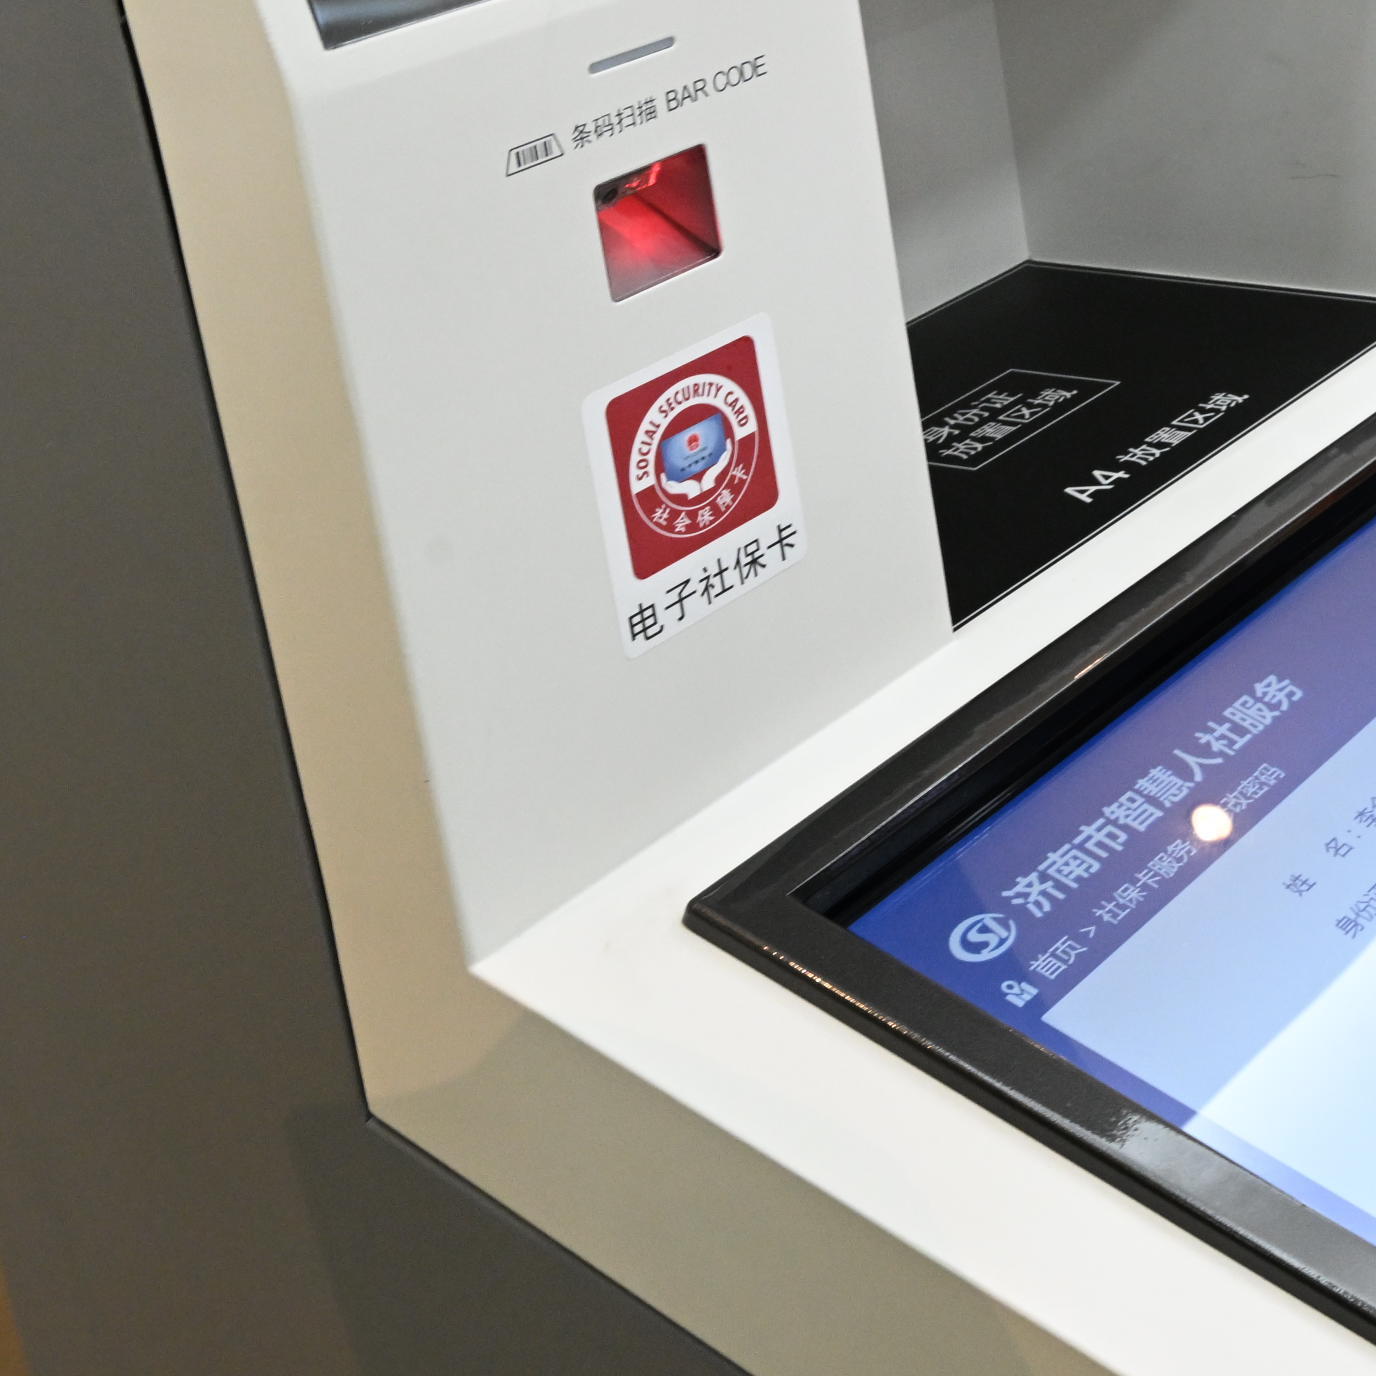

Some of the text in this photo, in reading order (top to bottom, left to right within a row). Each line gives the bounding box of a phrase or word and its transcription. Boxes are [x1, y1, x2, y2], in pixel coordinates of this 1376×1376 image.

[571, 54, 768, 150] 条码扫描 BAR CODE
[636, 421, 661, 481] SOCIAL
[659, 382, 723, 418] SECURITY
[724, 391, 748, 428] CARD
[923, 390, 1023, 444] 身份证
[939, 388, 1079, 460] 放置区域
[1064, 392, 1250, 504] A4 放置区域
[652, 464, 748, 532] 社会保障卡
[627, 522, 798, 644] 电子社保卡
[1001, 674, 1303, 918] 济南市智慧人社服务
